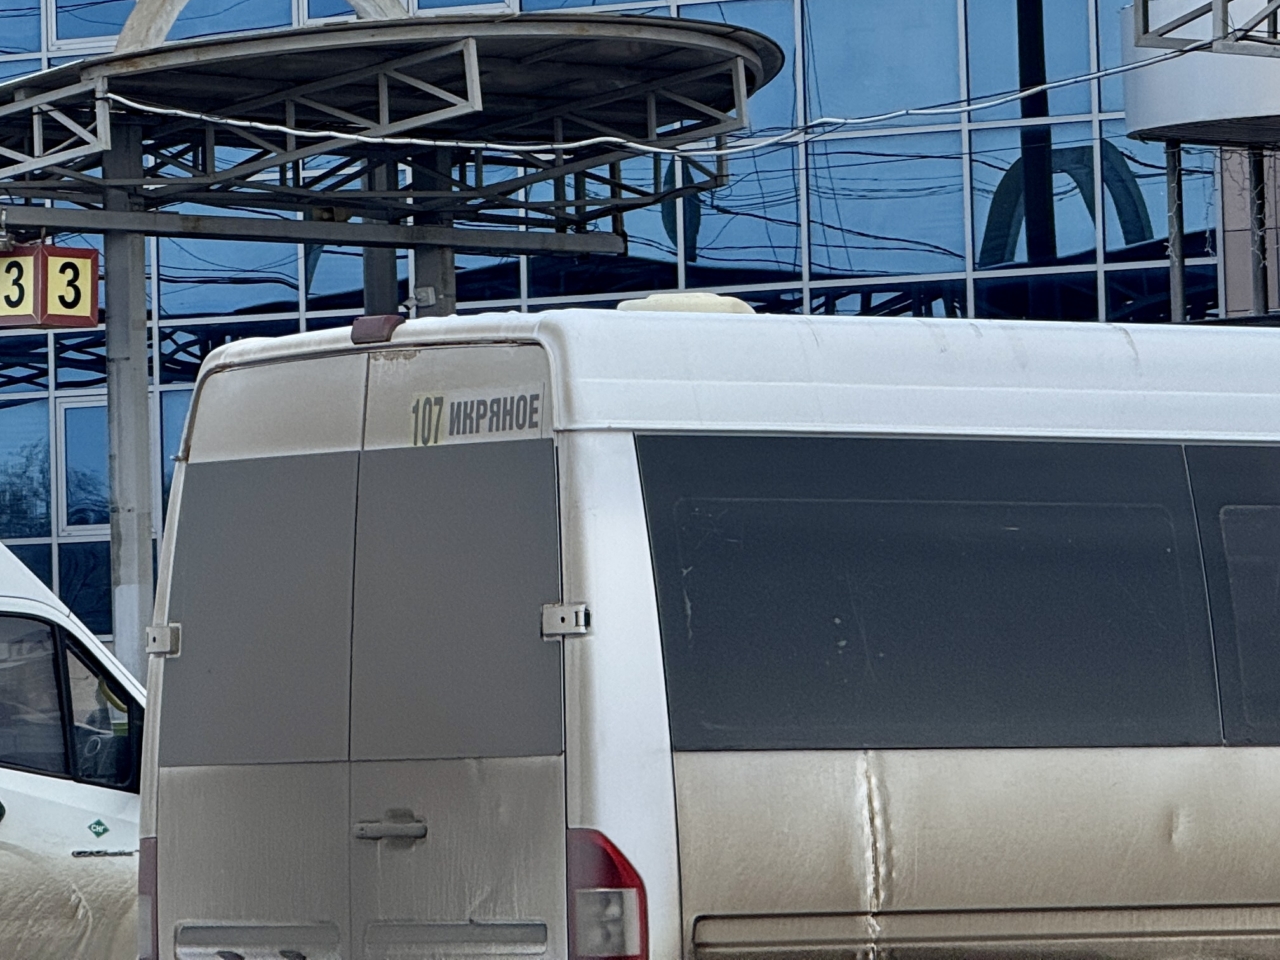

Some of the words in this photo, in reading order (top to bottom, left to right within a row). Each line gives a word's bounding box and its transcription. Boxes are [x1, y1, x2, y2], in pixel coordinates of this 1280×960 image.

[4, 260, 25, 308] 3
[58, 261, 82, 309] 3
[412, 396, 444, 446] 107
[448, 393, 540, 436] ИКРЯНОЕ
